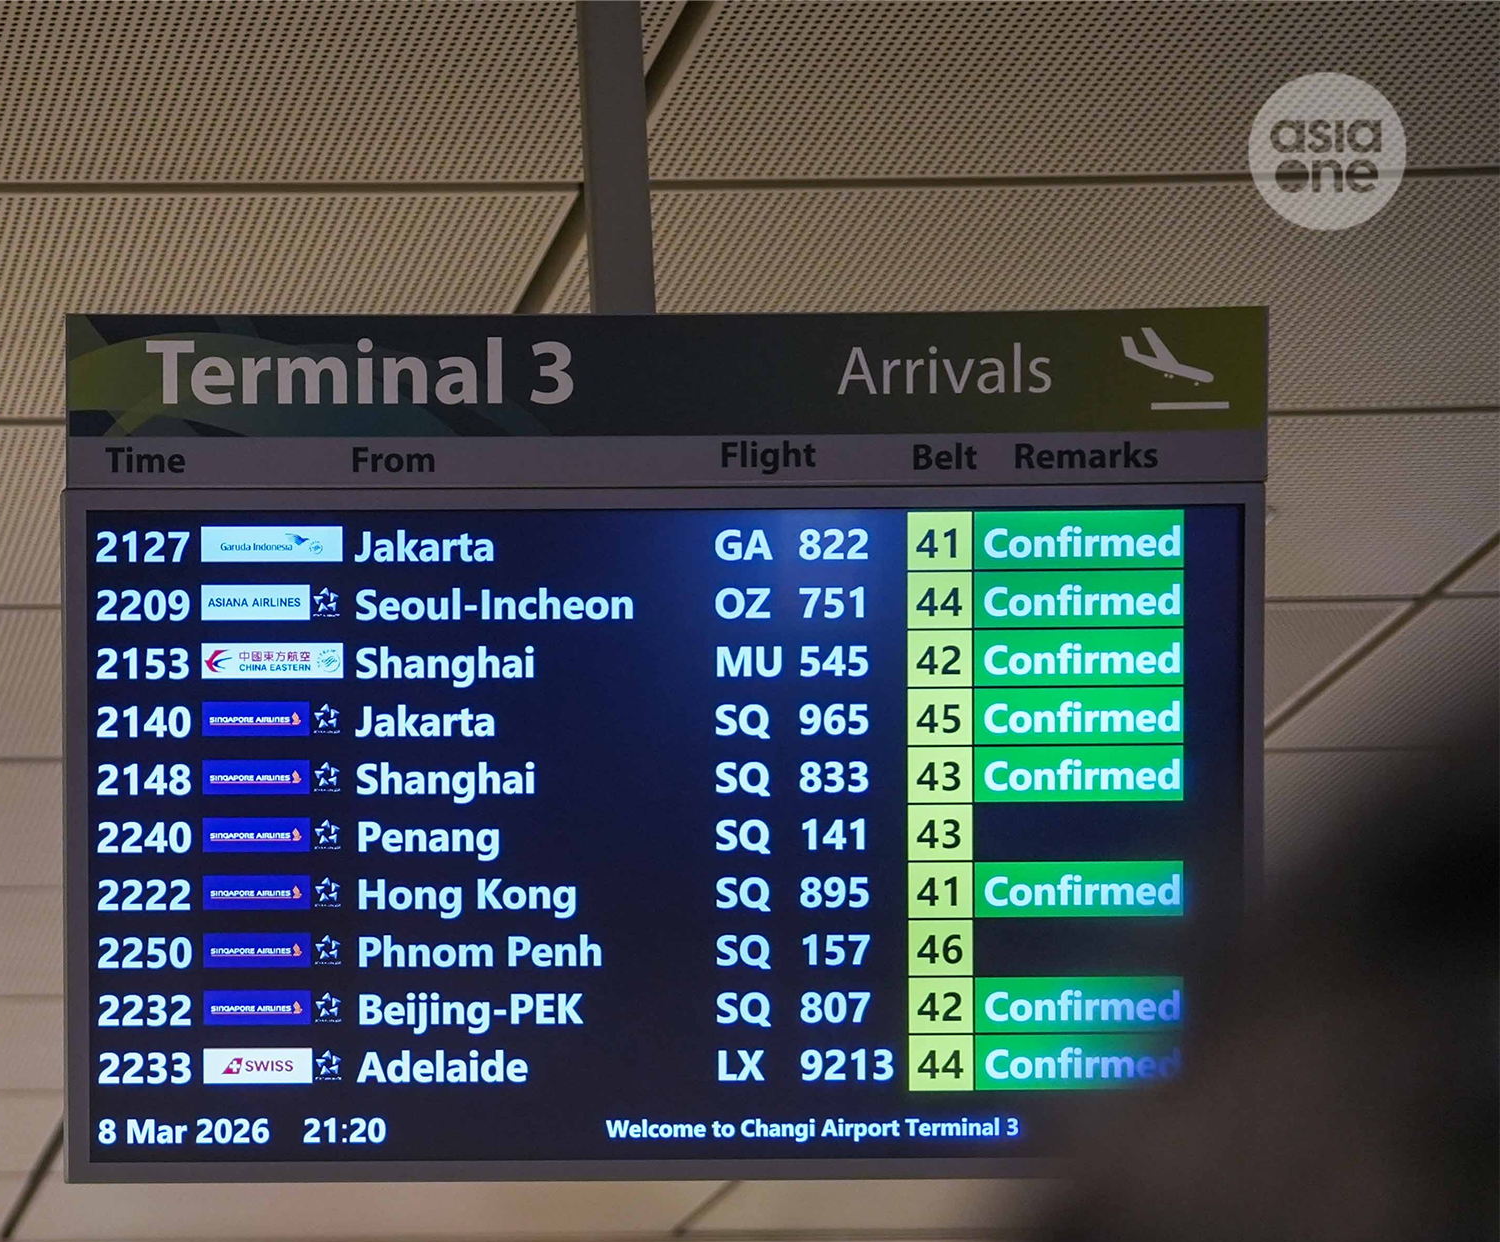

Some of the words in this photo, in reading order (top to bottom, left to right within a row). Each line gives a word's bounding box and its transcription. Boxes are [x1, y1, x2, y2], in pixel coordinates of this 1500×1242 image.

[145, 336, 503, 406] Terminal
[530, 341, 574, 405] 3
[837, 342, 1052, 395] Arrivals
[104, 446, 186, 474] Time
[352, 446, 435, 473] From
[721, 439, 816, 475] Flight
[912, 442, 978, 471] Belt
[1014, 440, 1159, 470] Remarks
[95, 530, 190, 563] 2127
[354, 529, 494, 563] Jakarta
[714, 529, 774, 561] GA
[798, 528, 869, 561] 822
[915, 527, 957, 559] 41
[983, 524, 1181, 559] Confirmed
[220, 543, 251, 551] Garuda
[253, 543, 293, 551] Indonesia
[96, 589, 190, 622] 2209
[355, 587, 634, 621] Seoul-Incheon
[715, 587, 771, 620] OZ
[798, 586, 865, 619] 751
[915, 587, 963, 617] 44
[984, 583, 1181, 617] Confirmed
[208, 598, 248, 607] ASIANA
[252, 598, 301, 607] AIRLINES
[96, 647, 190, 680] 2153
[355, 645, 535, 688] Shanghai
[716, 645, 782, 678] MU
[800, 645, 869, 678] 545
[916, 645, 961, 675] 42
[984, 642, 1181, 676] Confirmed
[239, 651, 310, 662] 中國東方航空
[97, 878, 191, 911] 2222
[358, 878, 462, 919] Hong
[477, 878, 576, 919] Kong
[716, 876, 771, 912] SQ
[799, 876, 870, 909] 895
[916, 876, 958, 907] 41
[984, 873, 1180, 907] Confirmed
[97, 936, 192, 969] 2250
[358, 934, 494, 968] Phnom
[507, 933, 602, 967] Penh
[716, 934, 772, 970] SQ
[802, 933, 871, 966] 157
[916, 934, 963, 965] 46
[98, 1051, 192, 1085] 2233
[356, 1049, 528, 1084] Adelaide
[717, 1049, 765, 1081] LX
[800, 1048, 894, 1081] 9213
[917, 1049, 964, 1080] 44
[984, 1046, 1180, 1080] Confirmed
[245, 1060, 294, 1072] SWISS
[98, 1118, 117, 1145] 8
[126, 1118, 188, 1144] Mar
[195, 1117, 270, 1144] 2026
[303, 1117, 386, 1143] 21:20
[605, 1118, 707, 1138] Welcome
[711, 1120, 736, 1138] to
[740, 1118, 816, 1143] Changi
[820, 1117, 900, 1143] Airport
[904, 1116, 1000, 1137] Terminal
[1006, 1117, 1019, 1136] 3
